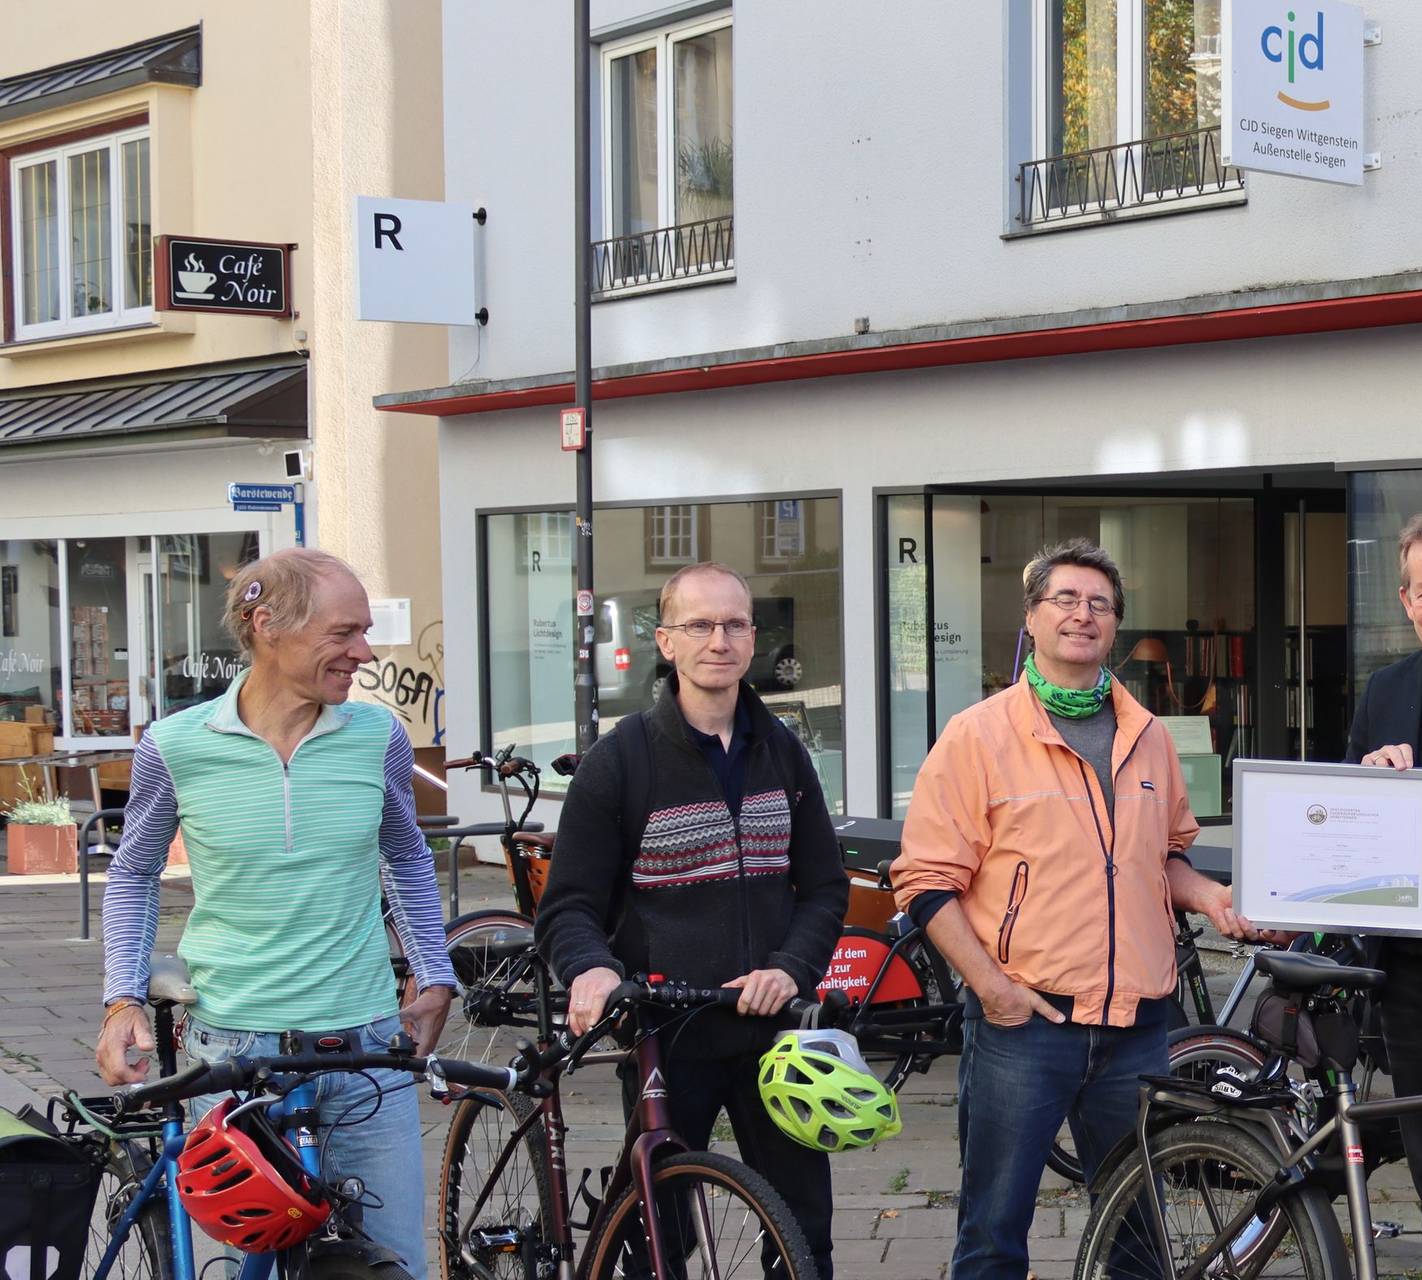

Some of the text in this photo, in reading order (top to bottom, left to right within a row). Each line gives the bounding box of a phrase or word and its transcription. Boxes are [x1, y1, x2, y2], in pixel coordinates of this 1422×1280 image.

[1261, 11, 1323, 83] cjd
[1240, 118, 1358, 150] CJD Siegen Wittgenstein
[1253, 142, 1346, 169] Außenstelle Siegen
[374, 212, 404, 251] R
[219, 253, 263, 282] Café
[220, 280, 277, 304] Noir
[532, 551, 541, 572] R
[899, 537, 918, 564] R
[0, 648, 44, 681] afé Noir
[183, 652, 243, 687] Café Noir
[845, 947, 867, 959] dem
[834, 963, 851, 974] zur
